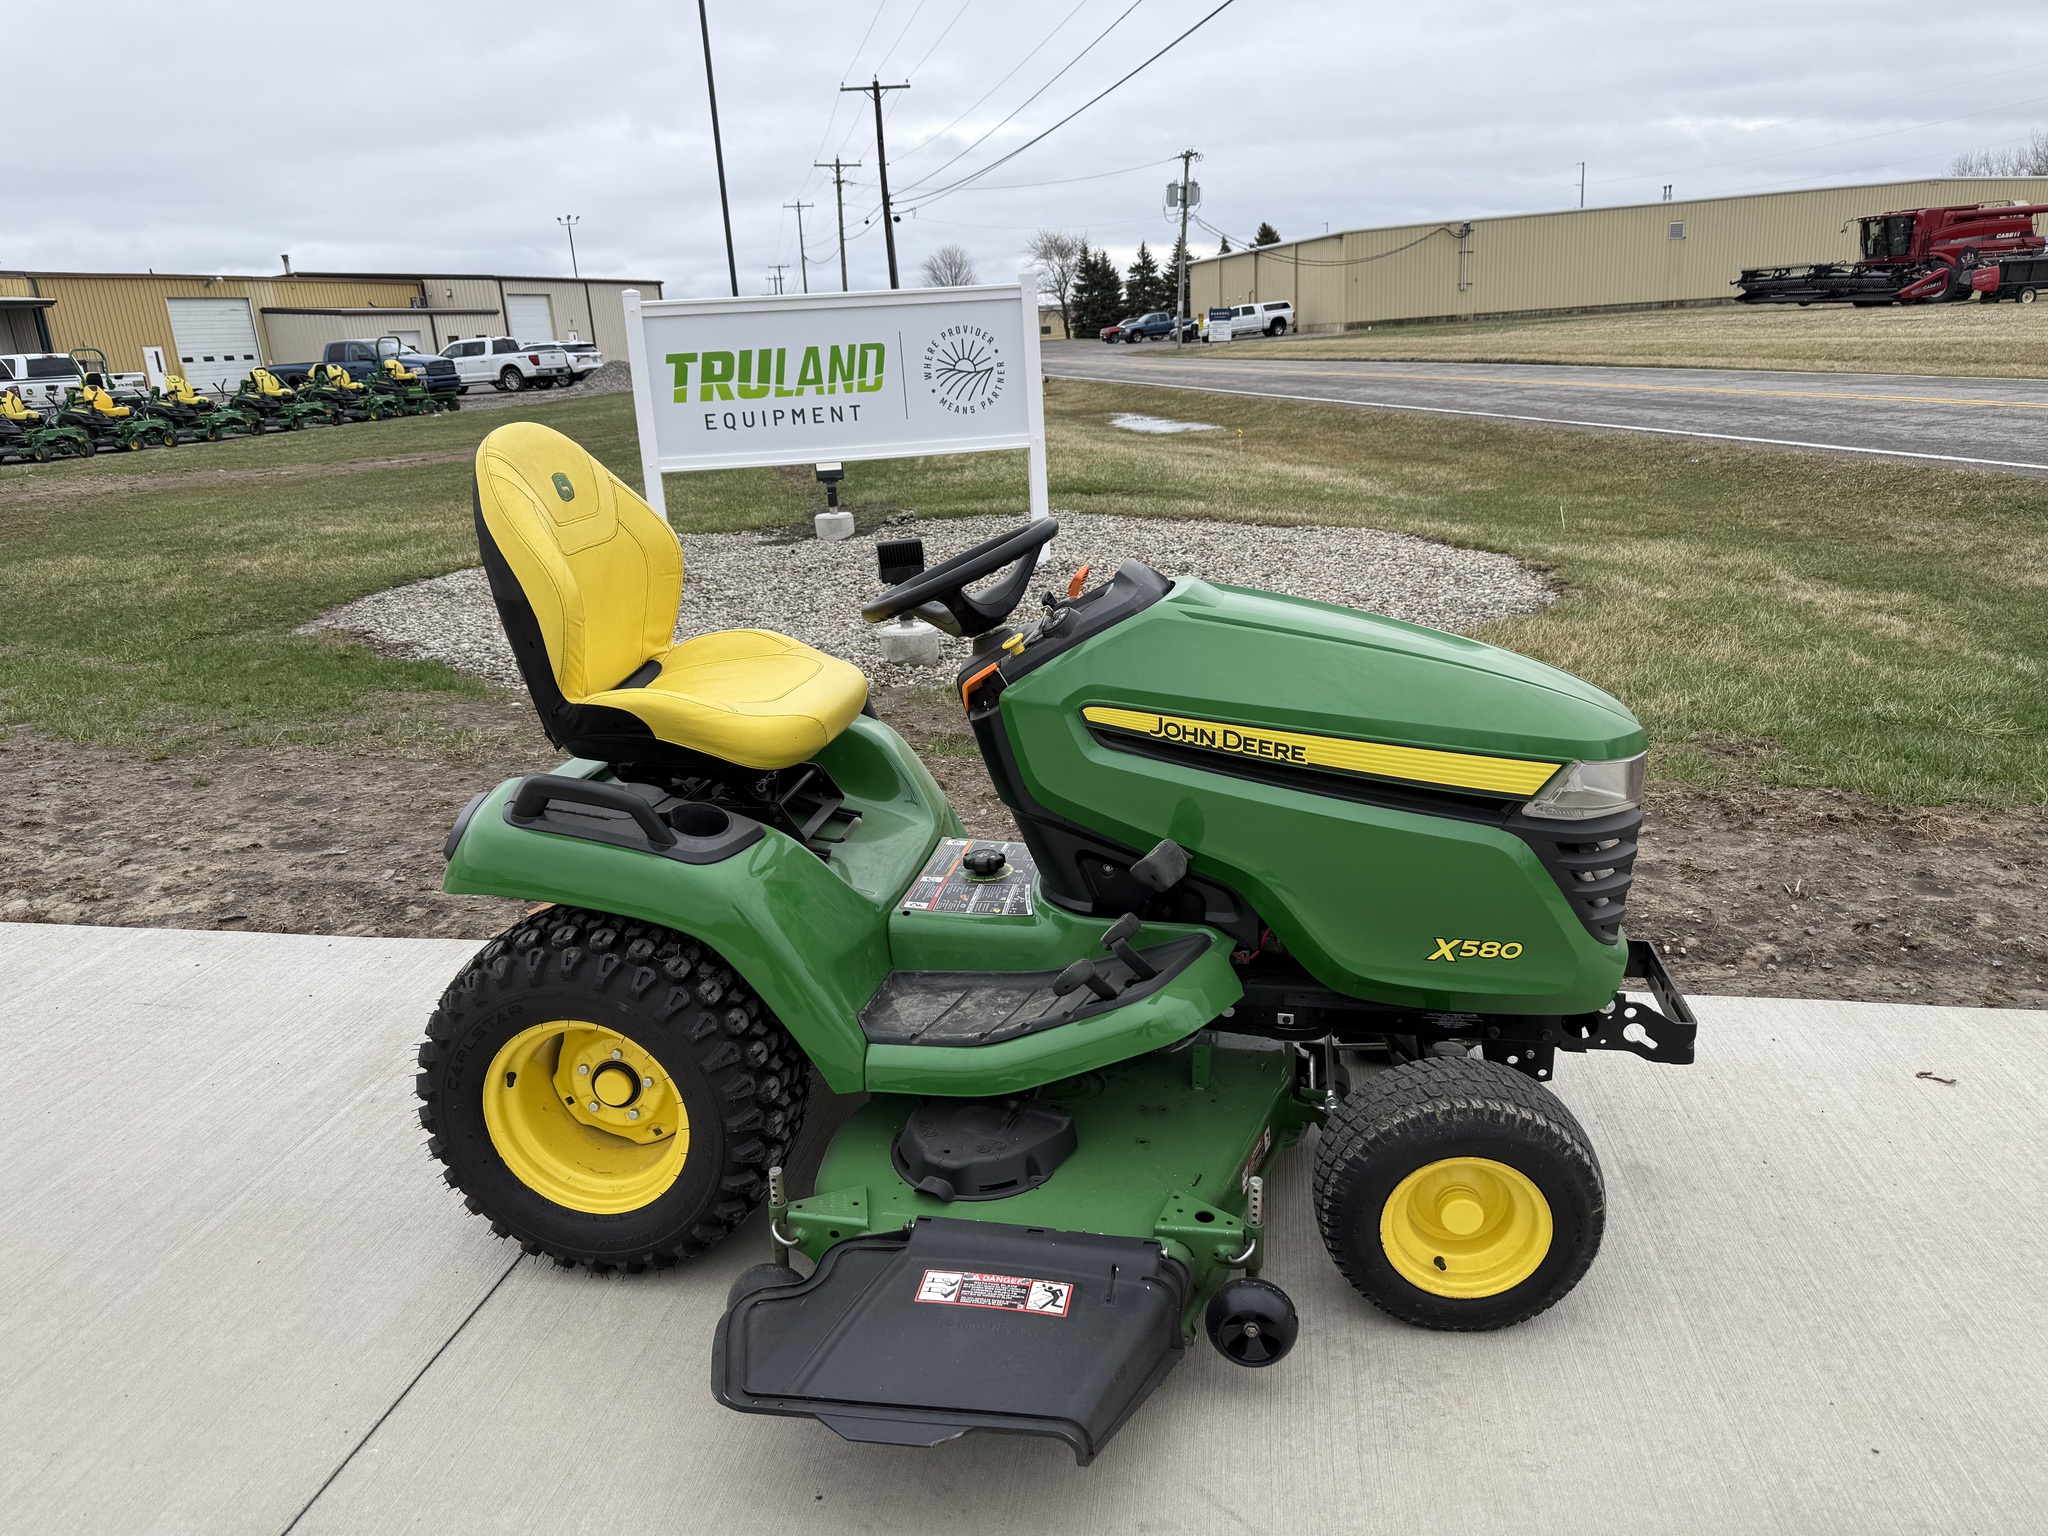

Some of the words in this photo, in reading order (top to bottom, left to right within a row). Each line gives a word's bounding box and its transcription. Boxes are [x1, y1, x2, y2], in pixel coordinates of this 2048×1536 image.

[665, 342, 886, 404] TRULAND
[923, 340, 940, 381] WHERE
[940, 325, 994, 345] PROVIDER
[939, 397, 976, 415] MEANS
[980, 361, 1006, 410] PARTNER
[704, 404, 861, 431] EQUIPMENT
[1150, 717, 1216, 746] JOHN
[1223, 729, 1306, 762] DEERE
[1425, 937, 1524, 961] X580
[982, 1275, 1023, 1285] DANGER
